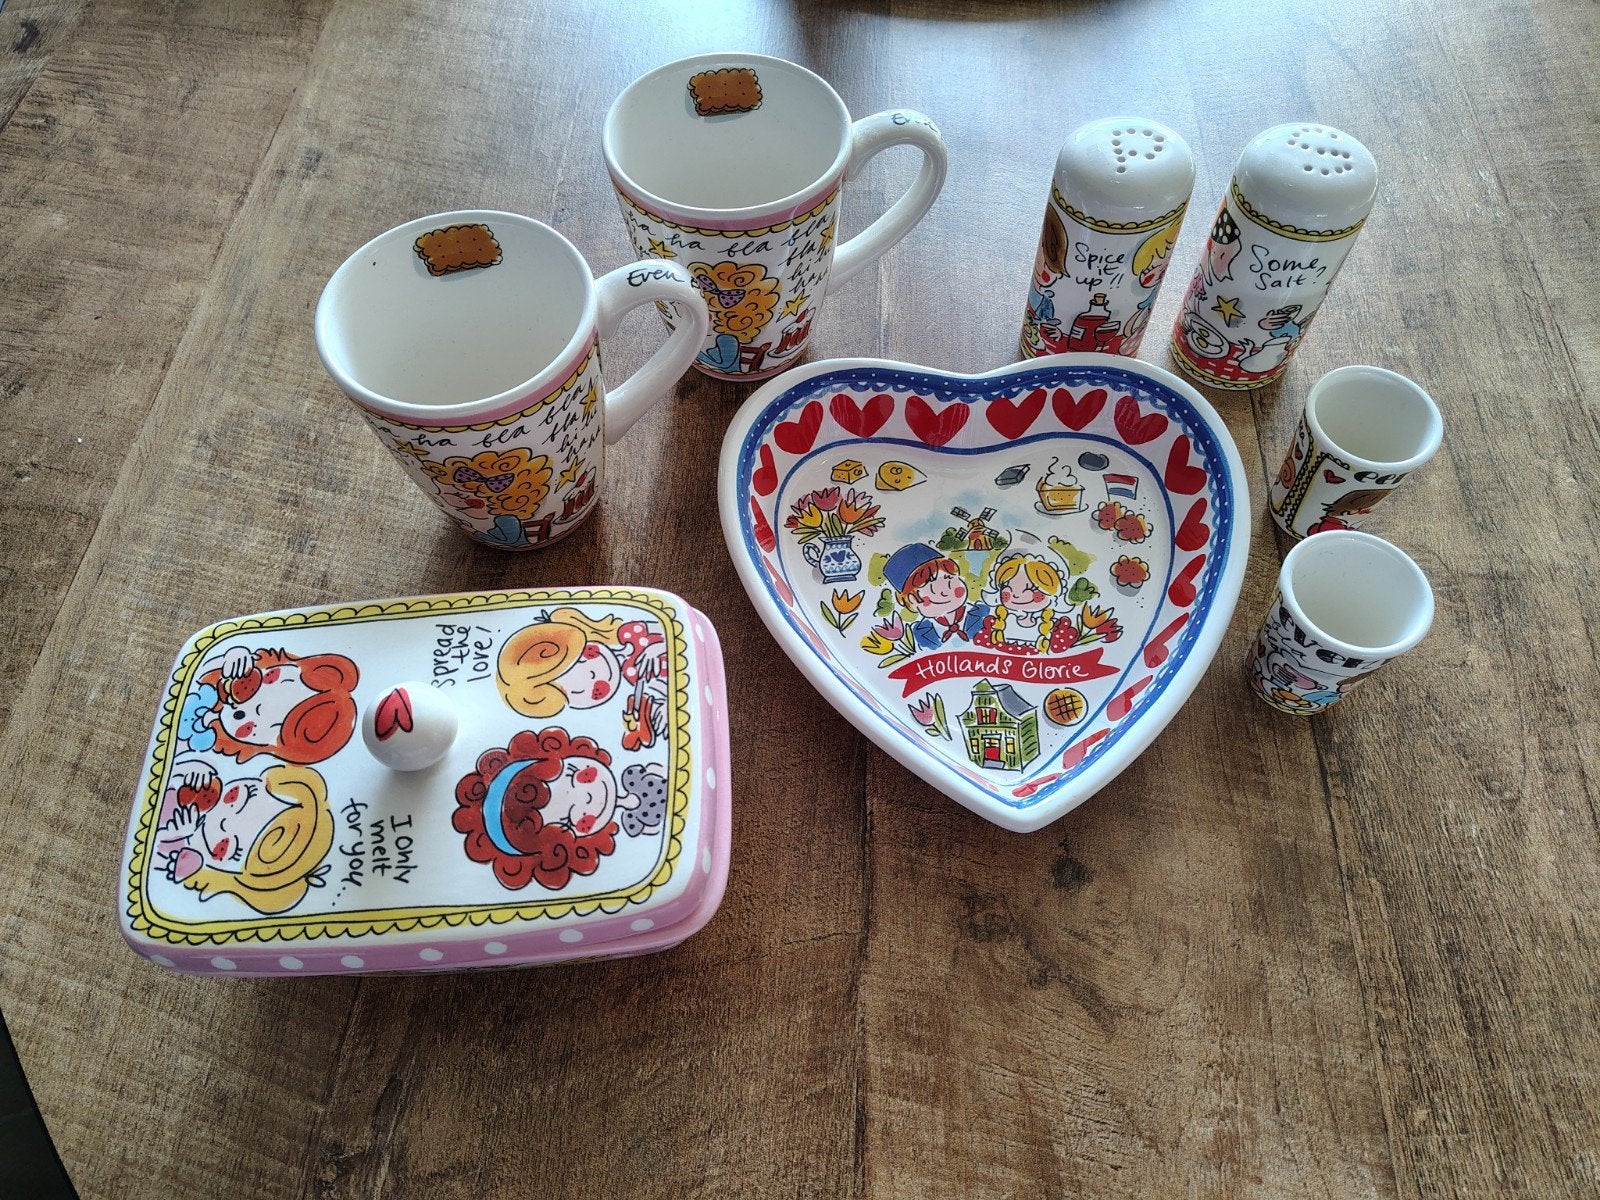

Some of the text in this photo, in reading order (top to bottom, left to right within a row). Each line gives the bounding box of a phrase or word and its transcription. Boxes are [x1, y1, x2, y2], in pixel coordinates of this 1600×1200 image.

[1074, 241, 1125, 270] Spice
[1097, 264, 1119, 276] it
[1249, 244, 1319, 273] Some
[626, 267, 686, 287] Even
[451, 625, 472, 664] the
[467, 625, 501, 682] love!
[915, 656, 1090, 680] Hollands Glorie
[340, 798, 368, 837] for
[370, 820, 392, 877] melt
[391, 814, 418, 885] I only
